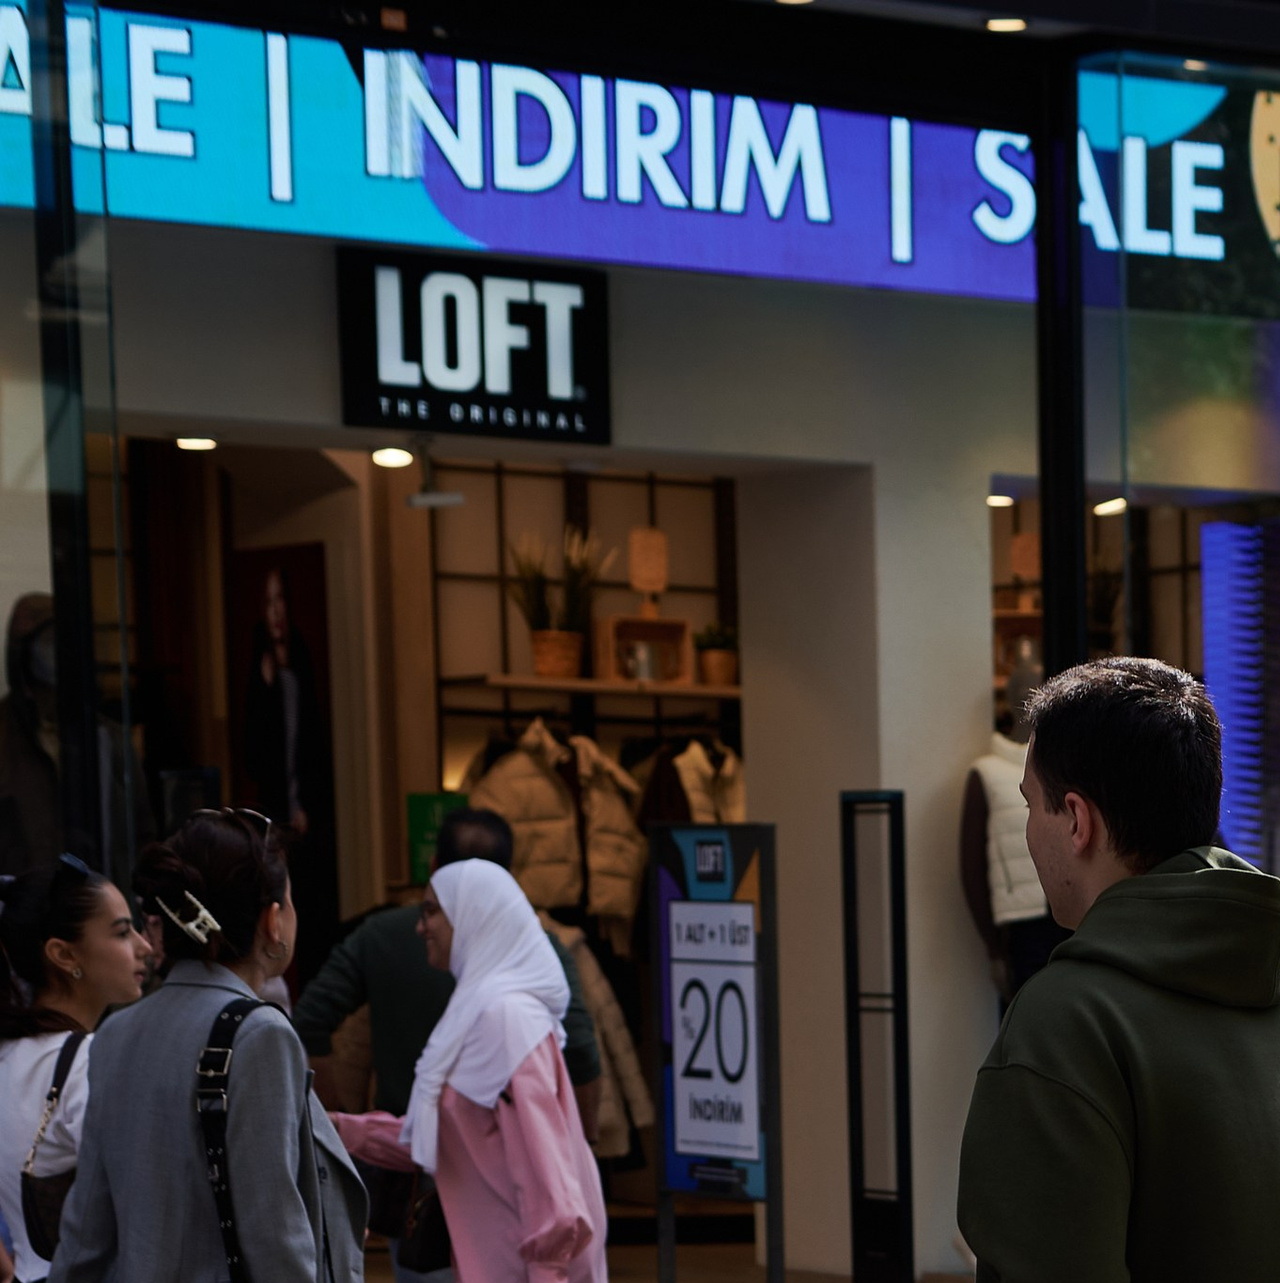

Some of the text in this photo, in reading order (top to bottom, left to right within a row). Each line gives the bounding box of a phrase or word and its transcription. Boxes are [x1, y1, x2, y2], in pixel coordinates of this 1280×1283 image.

[375, 266, 583, 399] LOFT
[379, 397, 586, 434] THE ORIGINAL
[696, 844, 723, 873] LOFT
